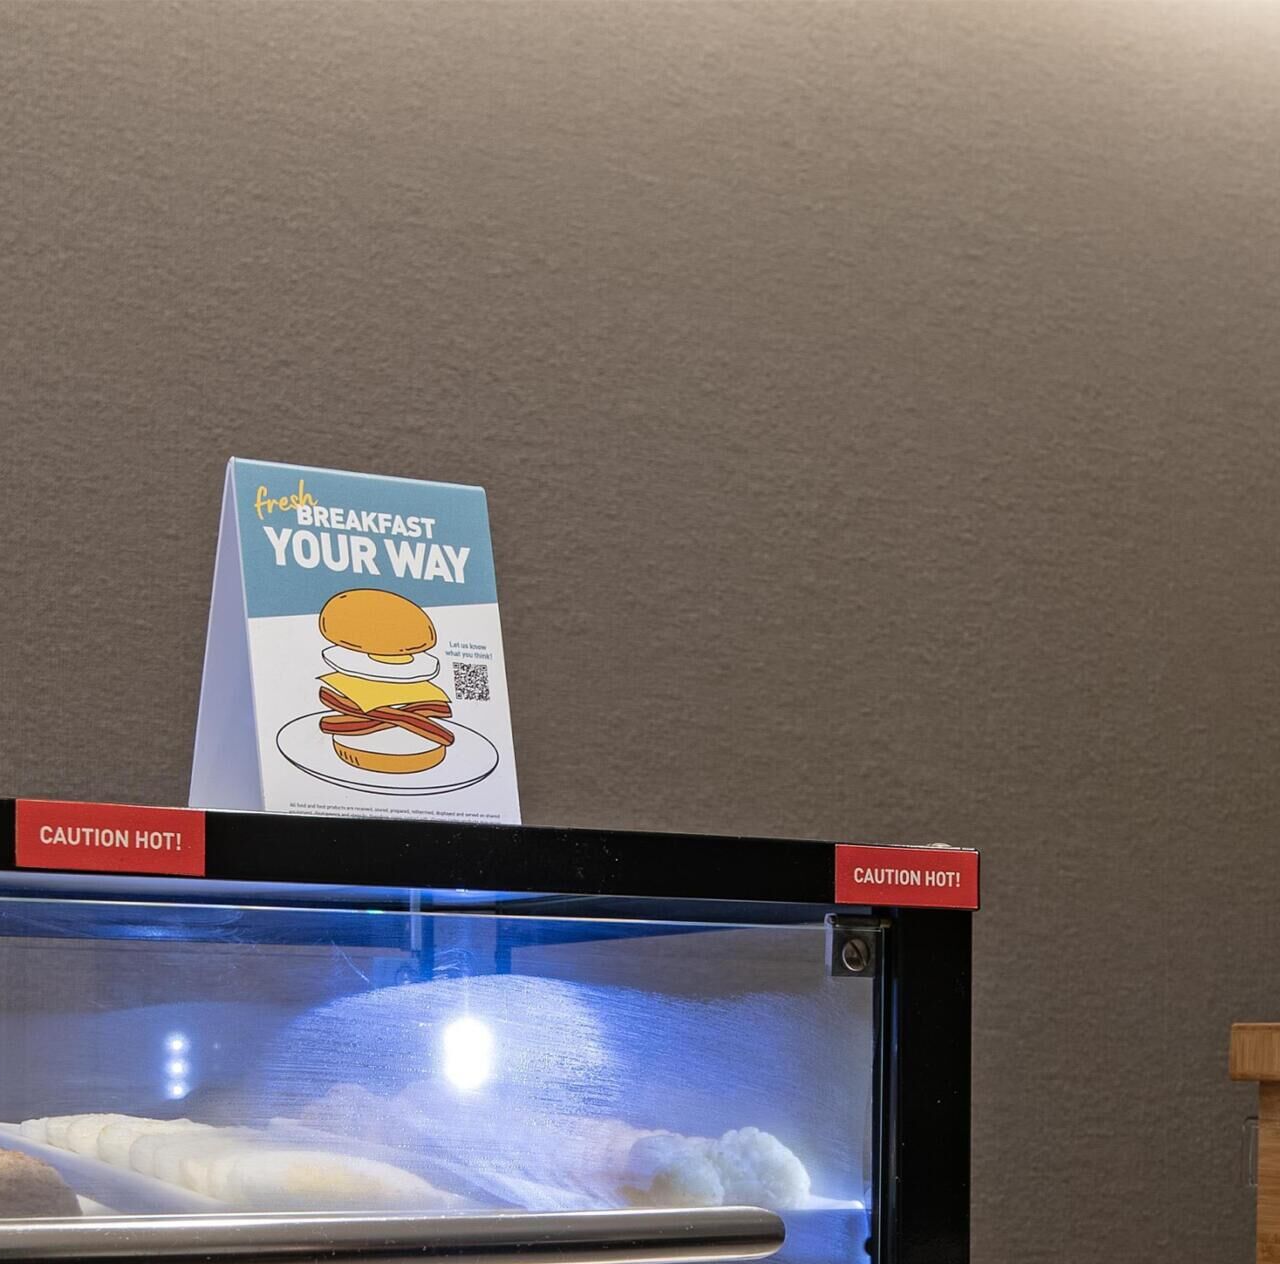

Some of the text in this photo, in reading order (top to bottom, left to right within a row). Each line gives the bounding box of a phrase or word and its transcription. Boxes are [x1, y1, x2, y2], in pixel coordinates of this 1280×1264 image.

[254, 480, 319, 520] fresh
[296, 504, 436, 539] BREAKFAST
[263, 526, 471, 584] YOUR WAY
[469, 642, 487, 650] know
[40, 826, 182, 851] CAUTION HOT!
[854, 867, 961, 888] CAUTION HOT!
